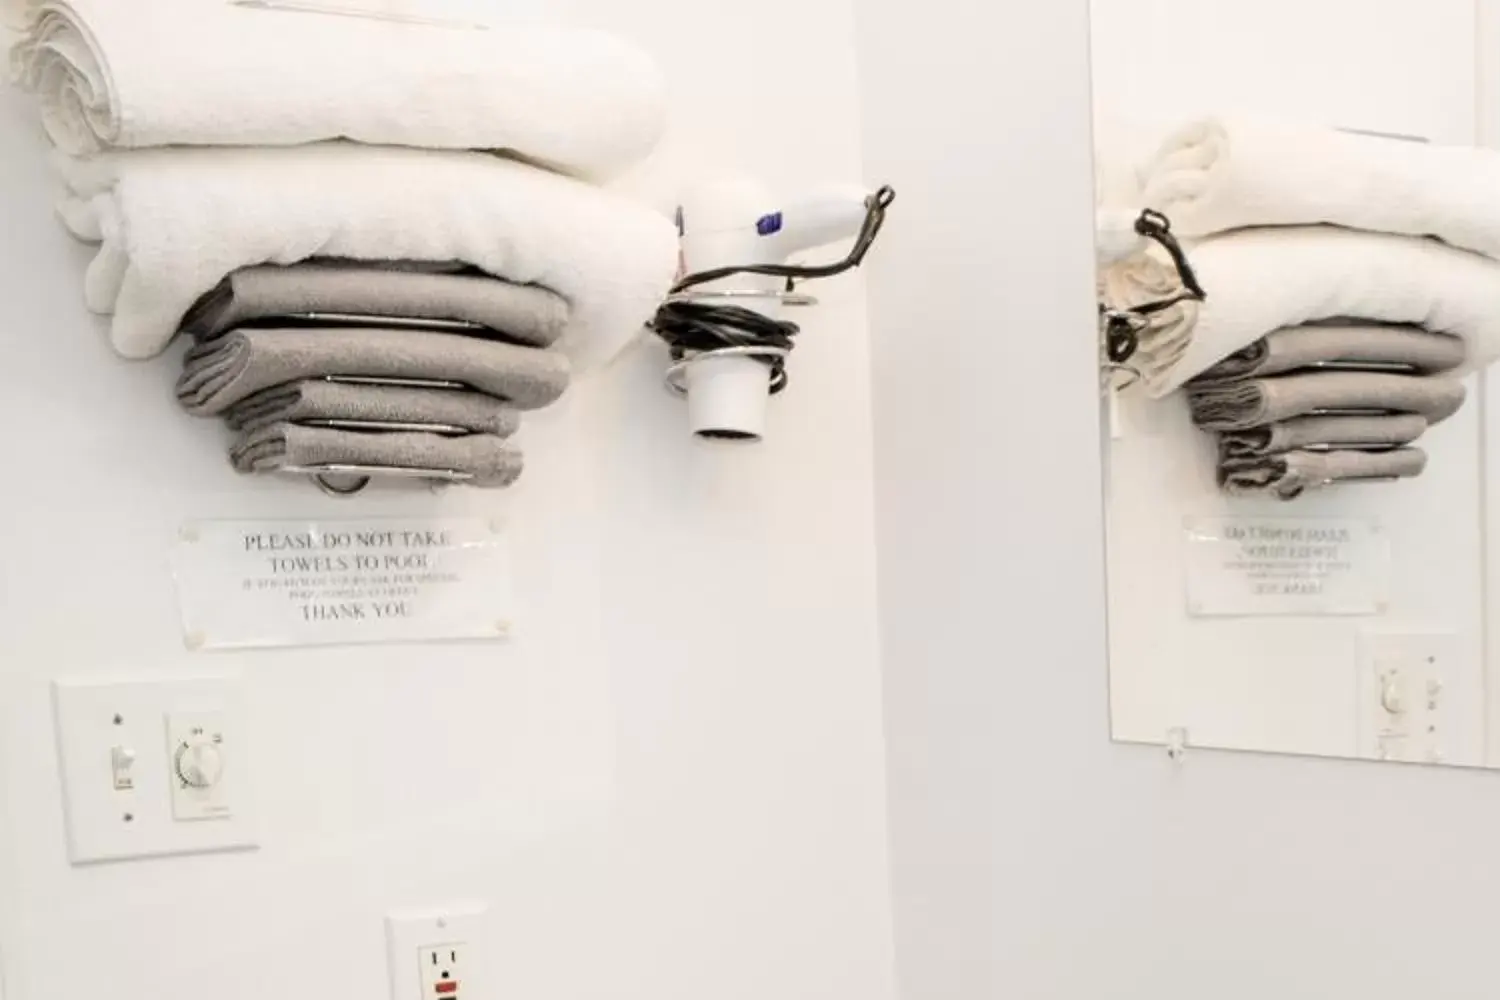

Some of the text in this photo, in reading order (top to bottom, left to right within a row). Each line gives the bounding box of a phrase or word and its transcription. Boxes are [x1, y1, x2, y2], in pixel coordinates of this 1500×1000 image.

[244, 529, 451, 551] PLEASE DO NOT TAKE
[267, 552, 433, 573] TOWELS TO POOL
[300, 599, 412, 621] THANK YOU
